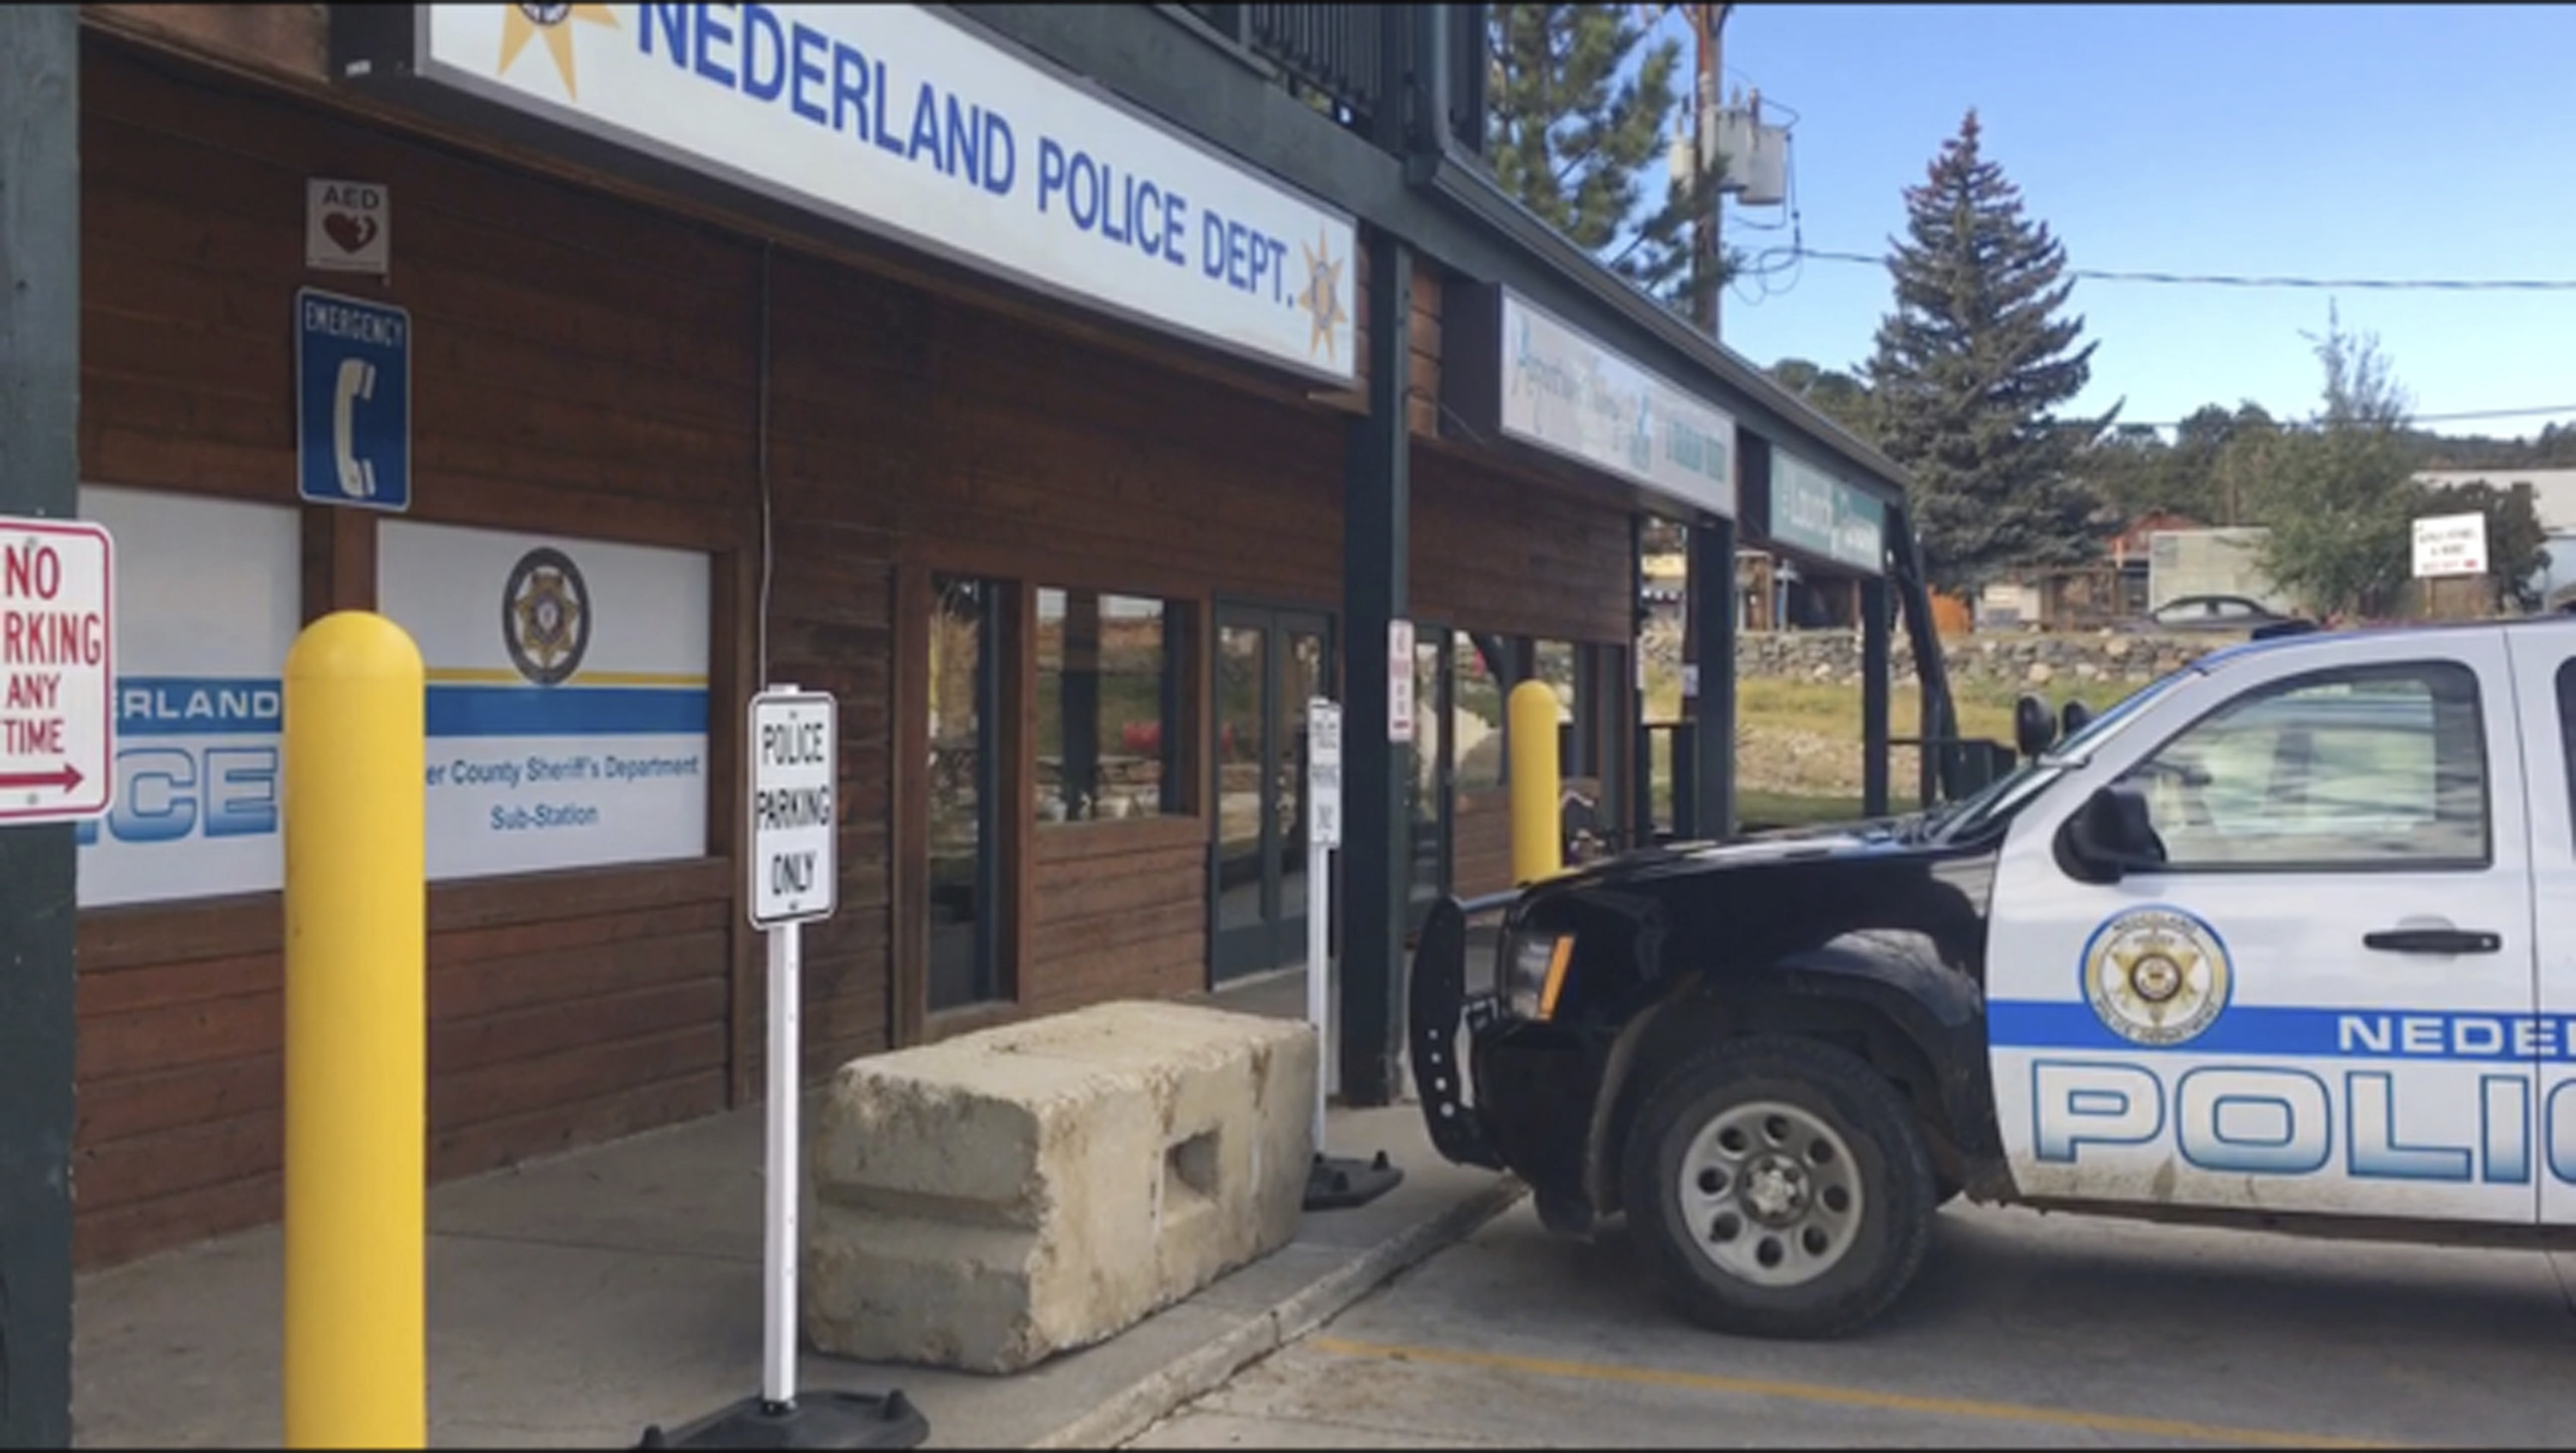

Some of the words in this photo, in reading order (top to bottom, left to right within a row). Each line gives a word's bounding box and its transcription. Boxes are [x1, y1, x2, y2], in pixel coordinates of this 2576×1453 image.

[638, 3, 1016, 196] NEDERLAND
[1038, 136, 1187, 265] POLICE
[1202, 209, 1295, 308] DEPT.
[322, 184, 380, 210] AED
[305, 301, 404, 347] EMERGENCY
[5, 544, 61, 600] NO
[3, 611, 101, 666] RKING
[6, 673, 61, 709] ANY
[116, 690, 280, 719] RLAND
[3, 718, 65, 756] TIME
[762, 722, 825, 765] POLICE
[451, 759, 523, 789] County
[526, 756, 600, 782] Sheriff's
[605, 755, 699, 782] Department
[76, 747, 277, 845] CE
[490, 802, 598, 830] Sub-Station
[756, 783, 831, 831] PARKING
[771, 850, 817, 896] ONLY
[2338, 1015, 2576, 1056] NEDE
[2032, 1058, 2576, 1186] POLI
